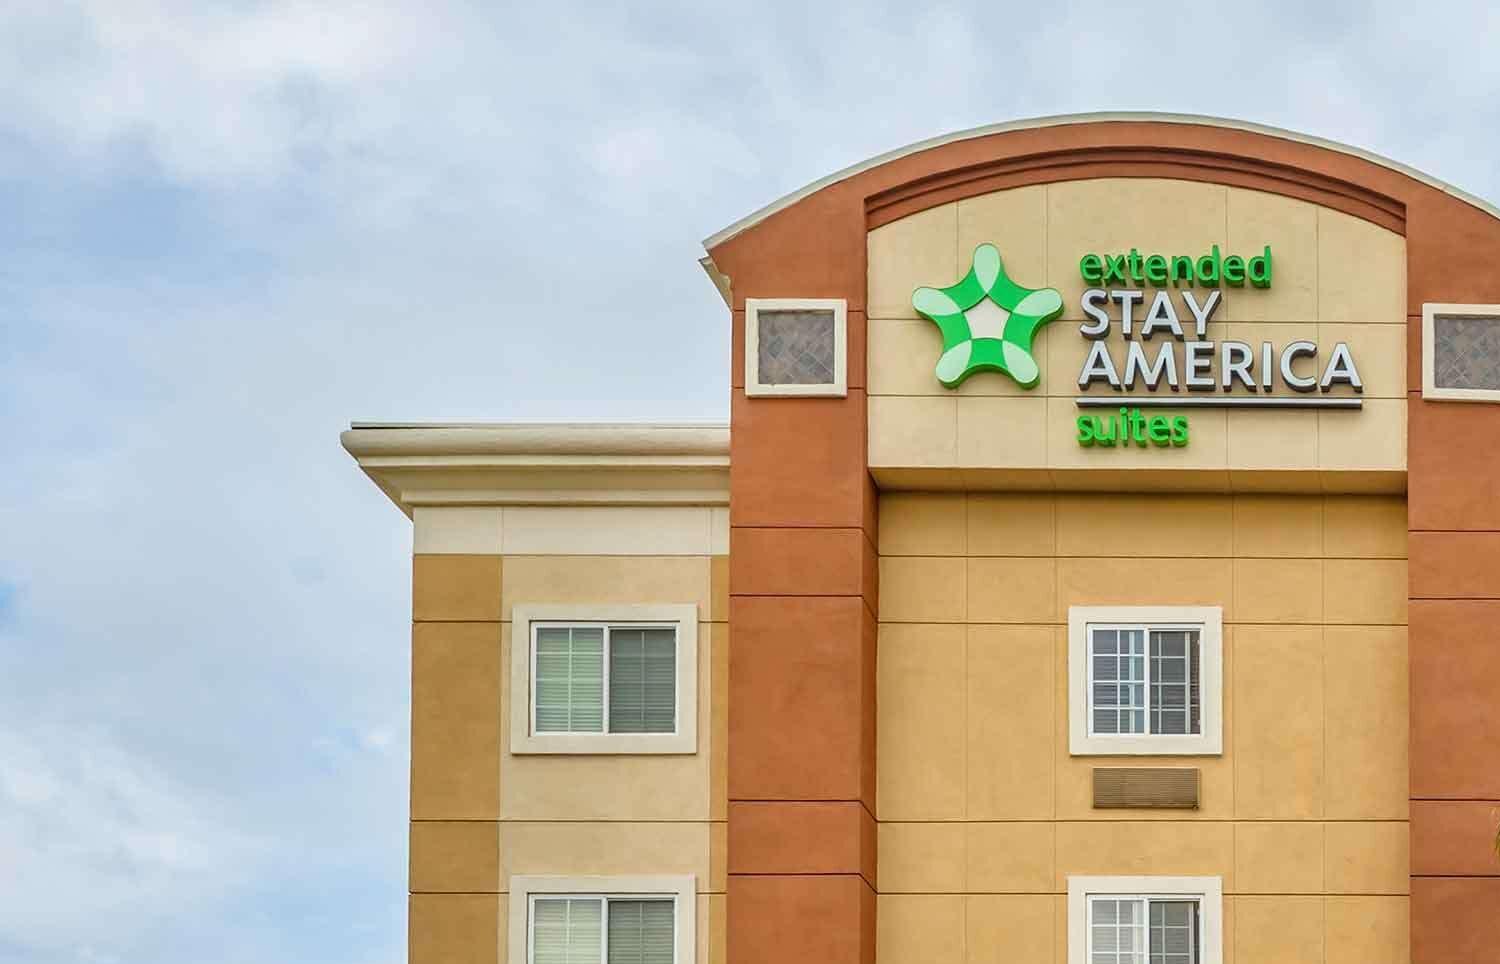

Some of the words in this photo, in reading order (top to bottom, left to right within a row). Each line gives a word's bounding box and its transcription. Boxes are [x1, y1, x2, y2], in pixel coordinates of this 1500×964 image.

[1079, 245, 1273, 288] extended
[1079, 289, 1222, 340] STAY
[1077, 340, 1363, 393] AMERICA
[1076, 407, 1189, 447] suites
